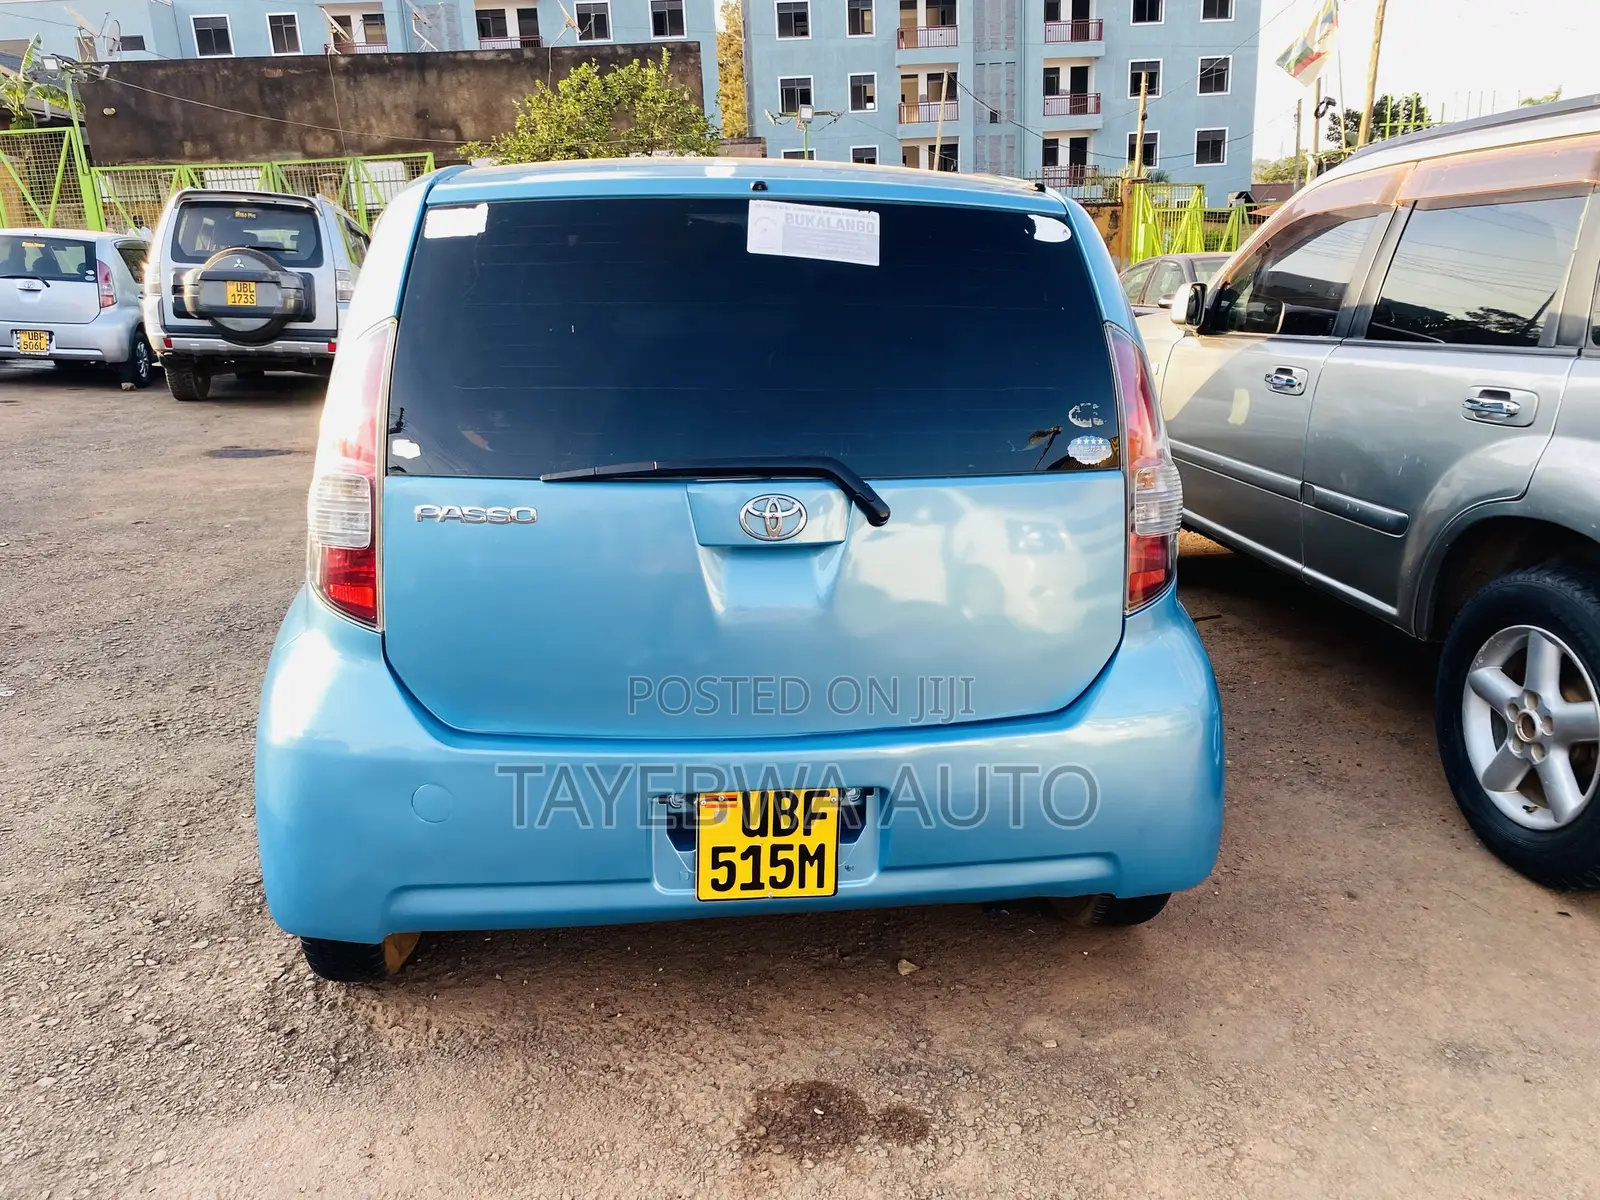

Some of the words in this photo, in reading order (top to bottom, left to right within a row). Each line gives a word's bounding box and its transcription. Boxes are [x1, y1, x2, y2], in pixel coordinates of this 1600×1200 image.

[785, 212, 876, 233] BUKALANGO
[236, 282, 255, 293] UBL
[231, 293, 255, 305] 173S
[28, 331, 45, 341] UBF
[23, 340, 45, 351] 506L
[414, 504, 538, 524] PASSO
[741, 789, 831, 838] UBF
[710, 843, 826, 892] 515M
